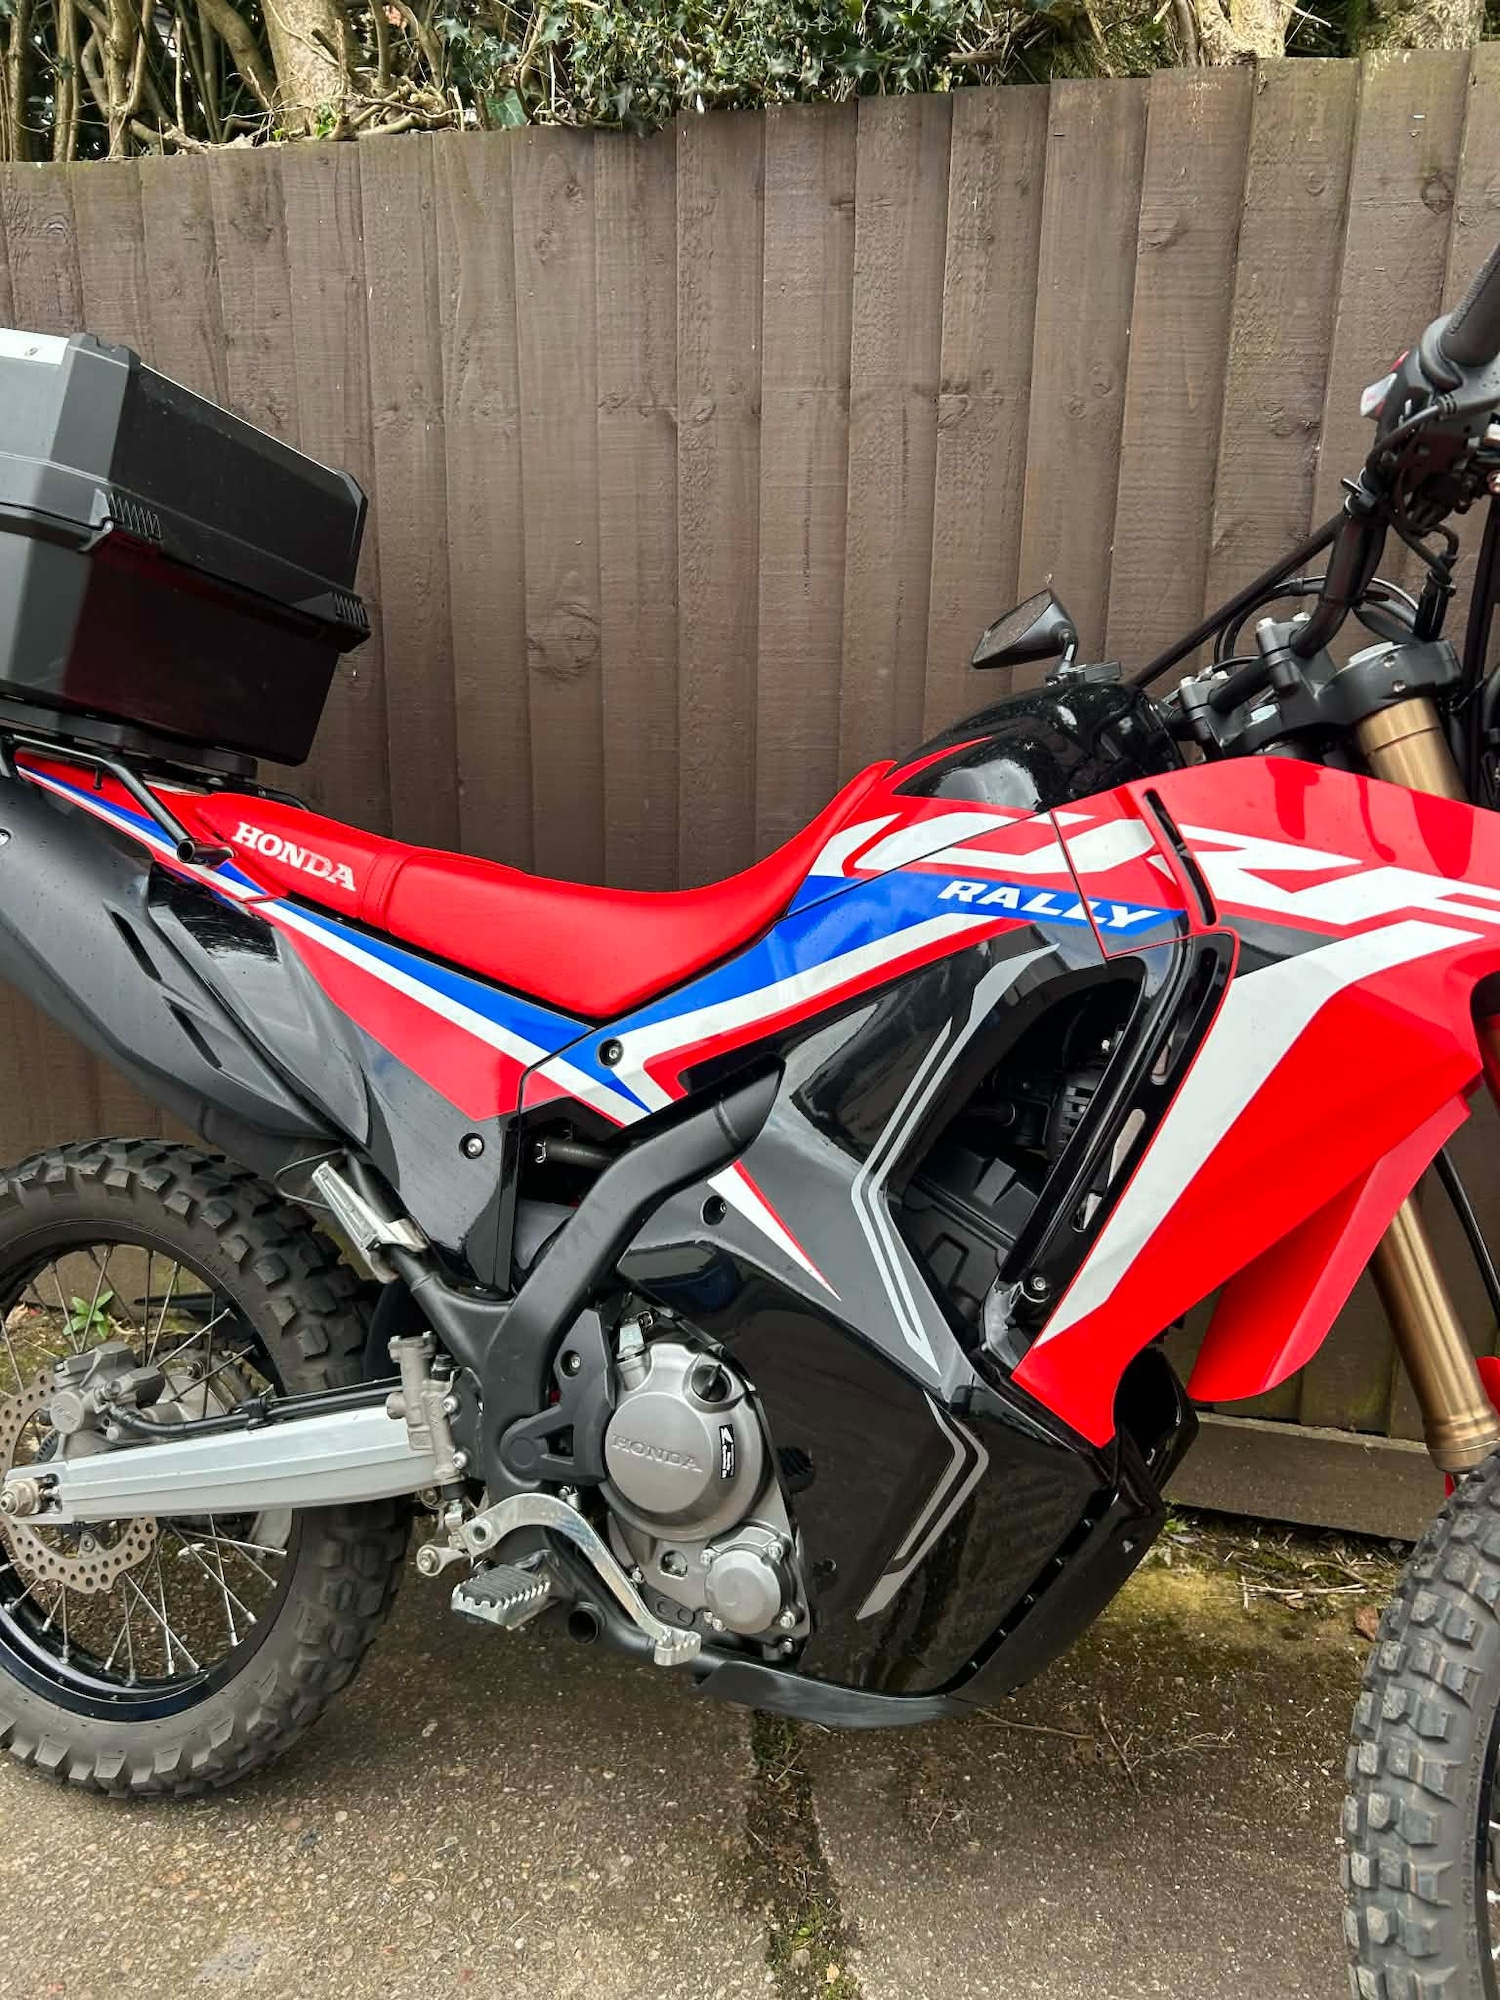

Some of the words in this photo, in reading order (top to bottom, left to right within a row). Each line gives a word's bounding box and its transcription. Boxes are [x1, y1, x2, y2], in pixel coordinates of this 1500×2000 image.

[232, 821, 356, 892] HONDA
[937, 880, 1162, 928] RALLY
[612, 1433, 703, 1473] HONDA
